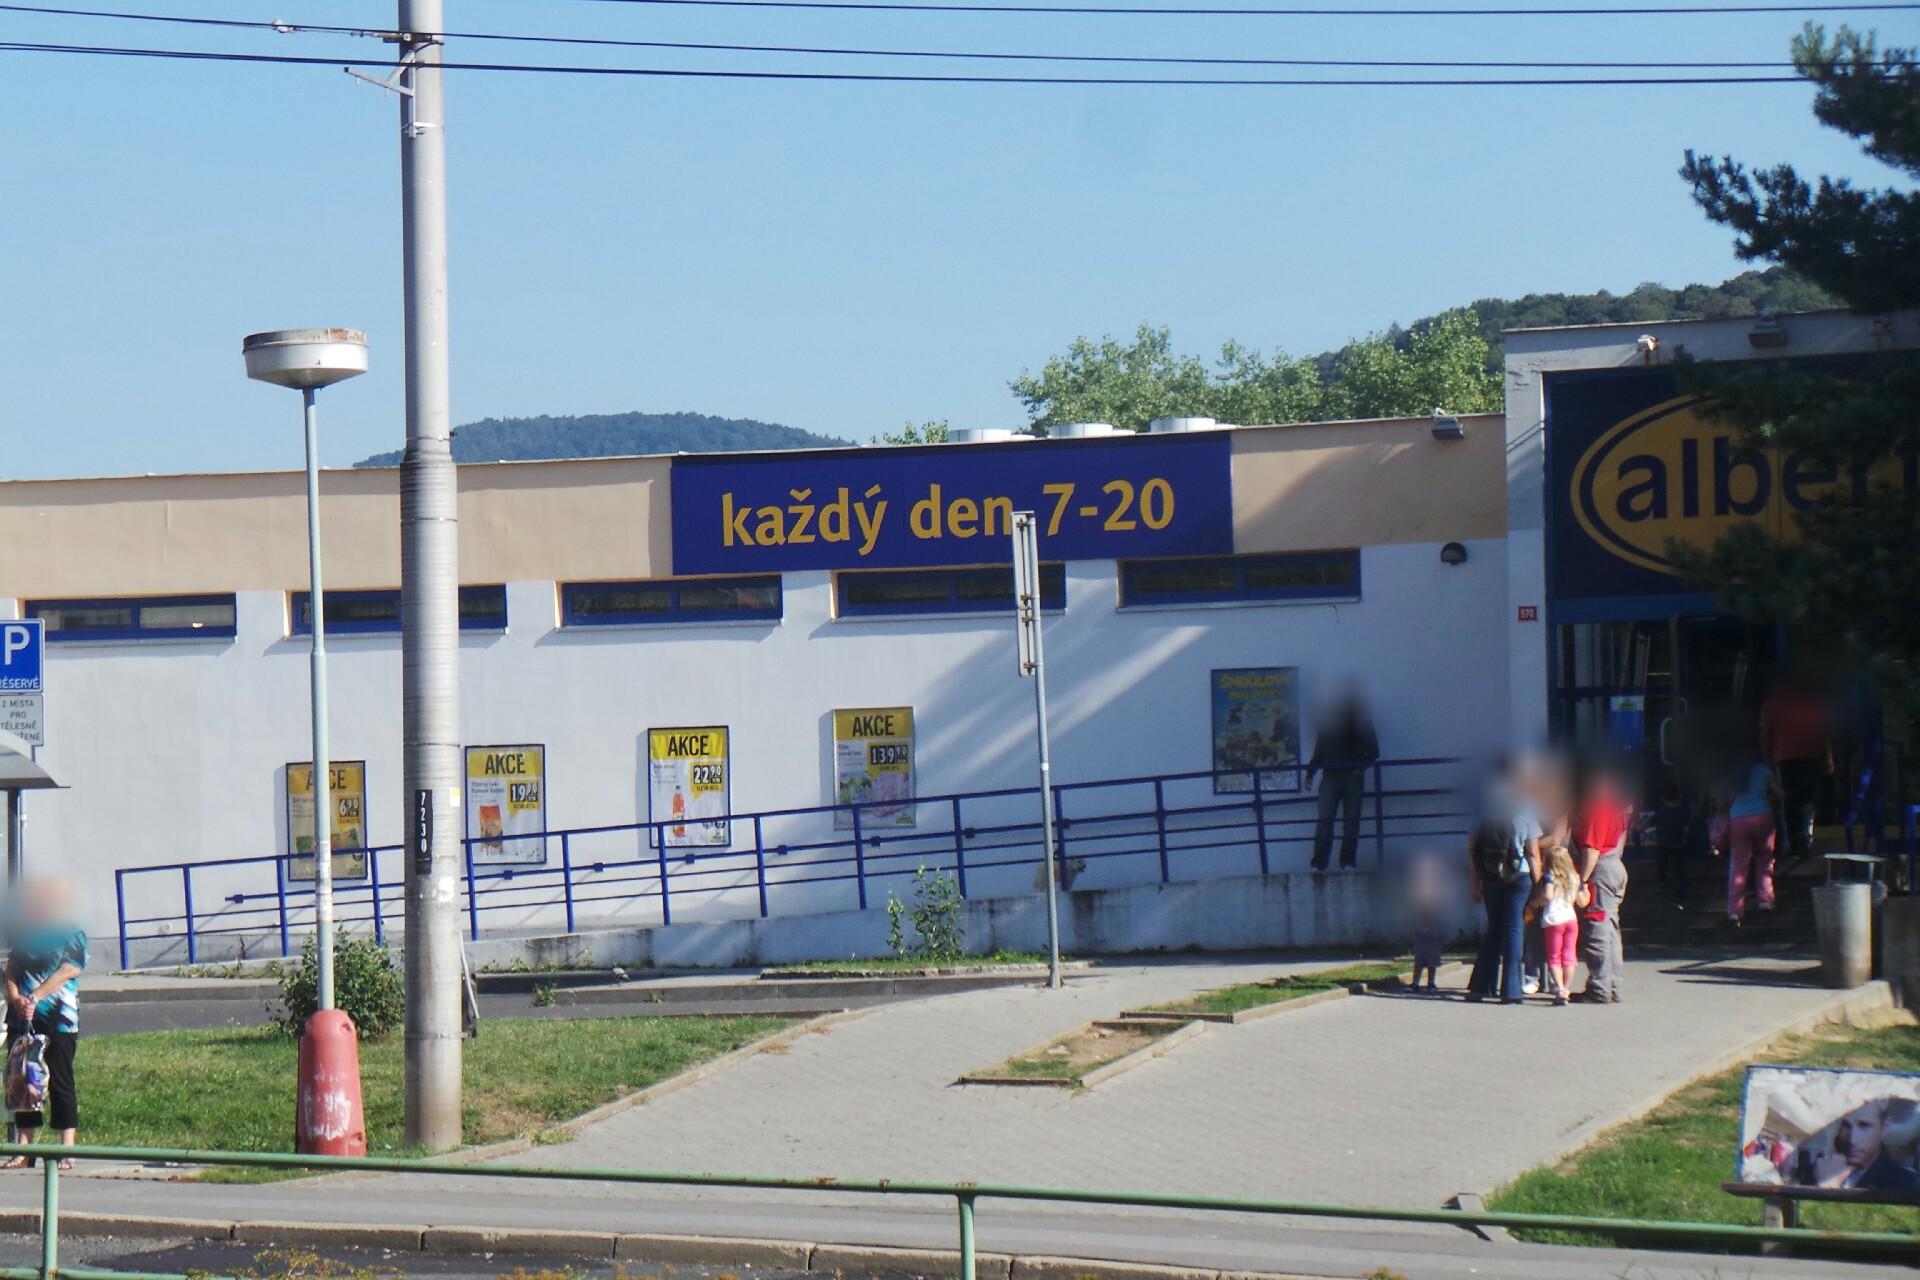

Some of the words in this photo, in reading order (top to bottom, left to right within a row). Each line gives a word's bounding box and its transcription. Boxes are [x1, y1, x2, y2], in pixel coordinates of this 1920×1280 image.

[722, 484, 888, 556] každý
[910, 483, 1013, 538] den
[1042, 478, 1175, 537] 7-20
[4, 625, 30, 665] P
[10, 711, 27, 719] PRO
[852, 715, 895, 737] AKCE
[668, 735, 710, 756] AKCE
[485, 754, 526, 775] AKCE
[306, 769, 347, 790] ACE
